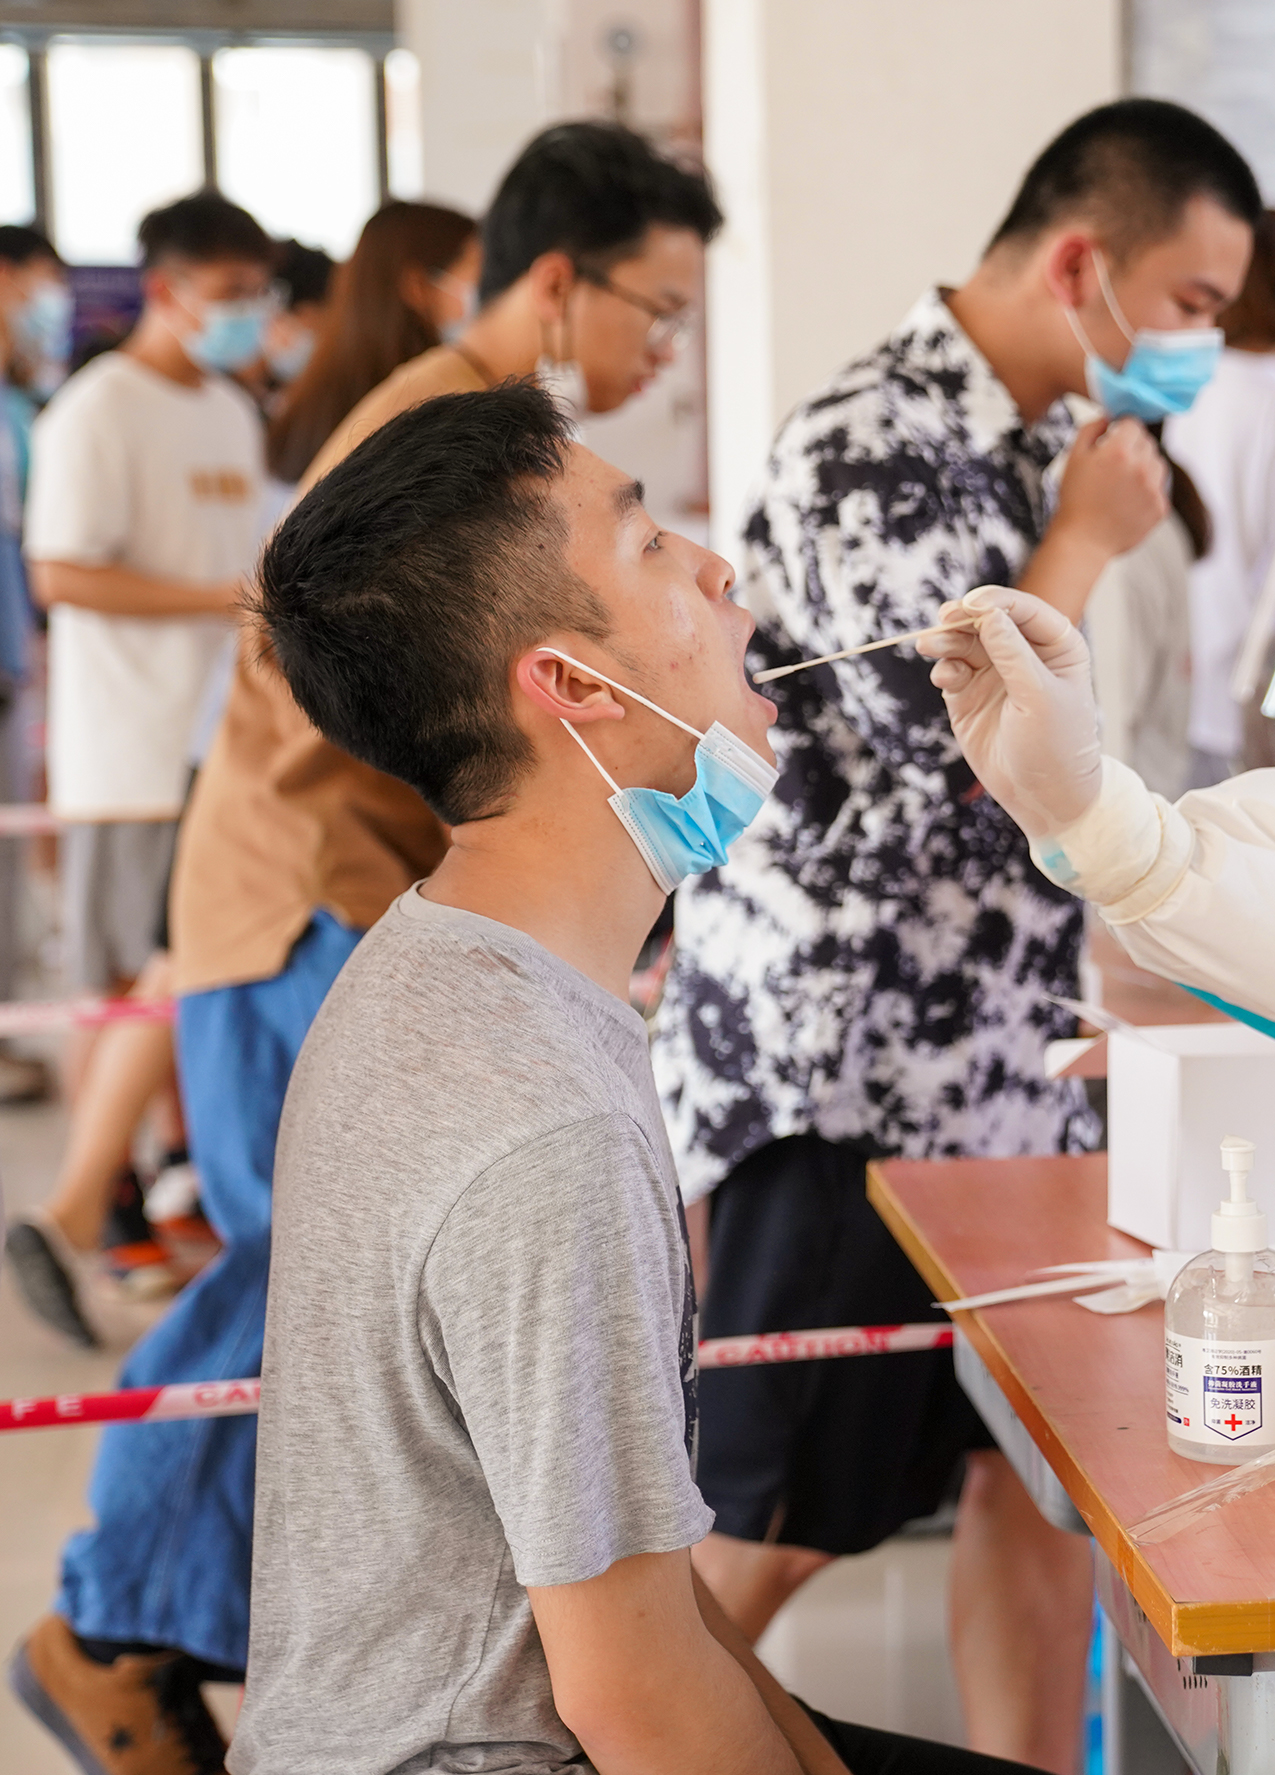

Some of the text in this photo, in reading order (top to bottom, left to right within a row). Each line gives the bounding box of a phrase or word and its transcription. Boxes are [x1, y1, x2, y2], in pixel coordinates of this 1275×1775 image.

[1204, 1364, 1262, 1376] 含75%酒精
[194, 1383, 261, 1408] CA
[1210, 1397, 1256, 1410] 免洗凝胶
